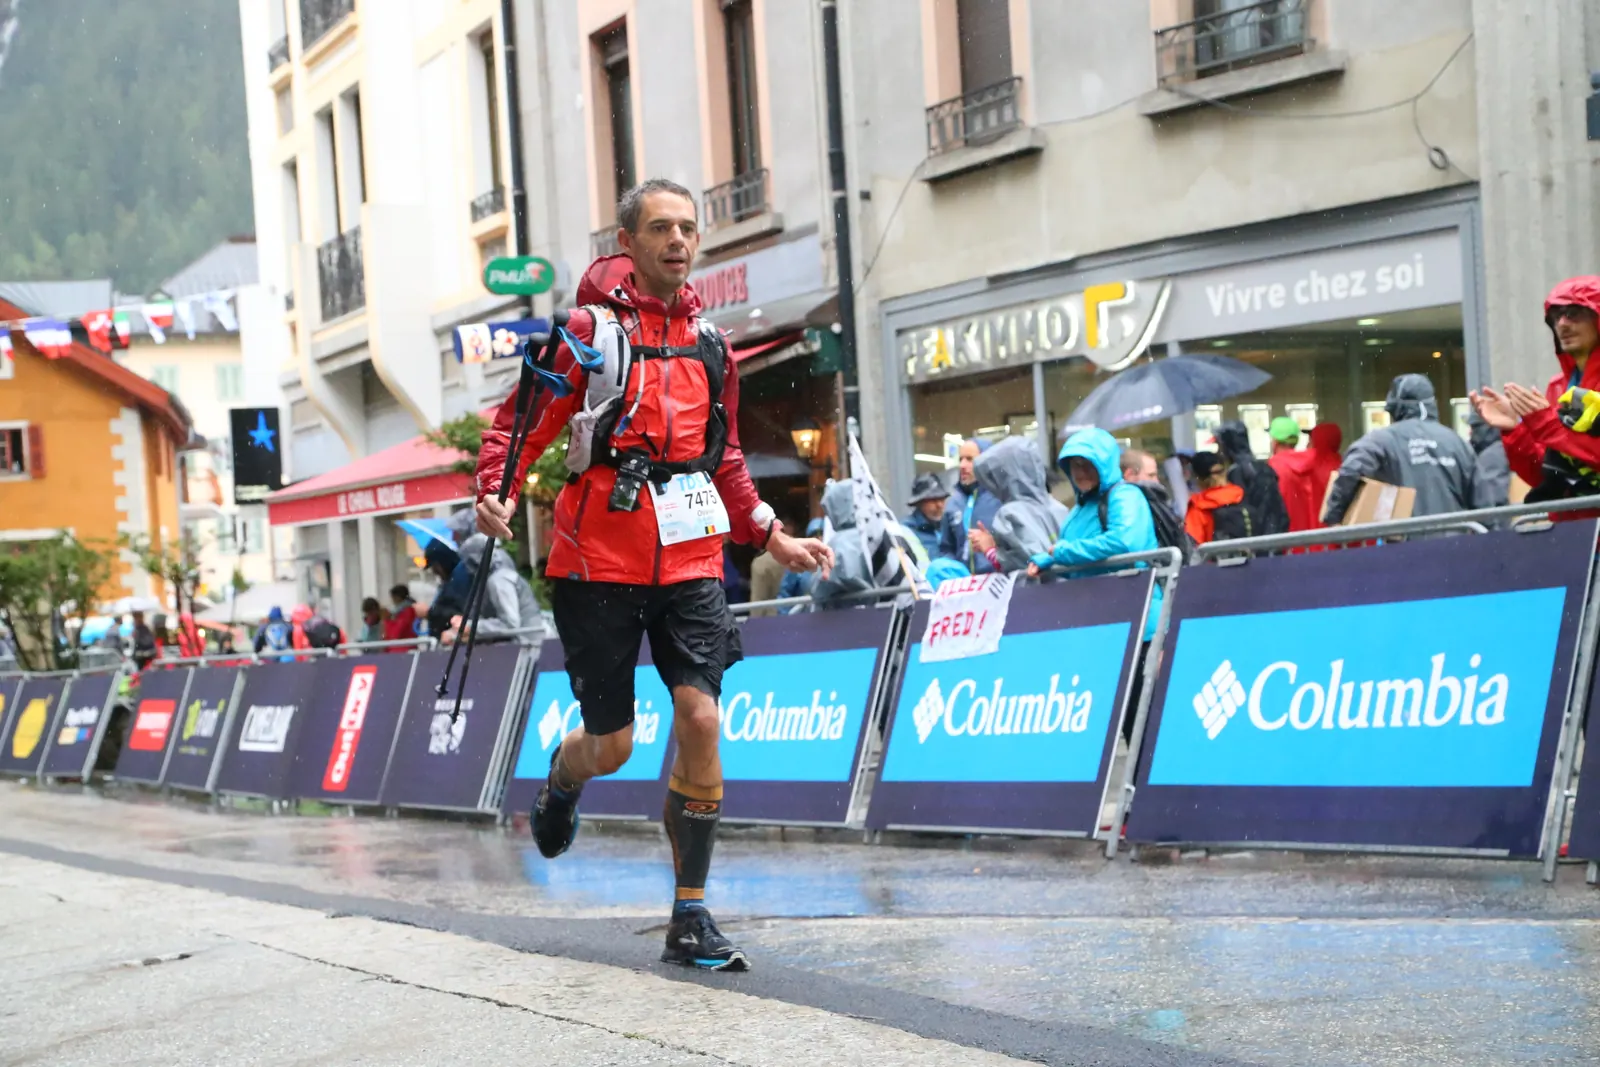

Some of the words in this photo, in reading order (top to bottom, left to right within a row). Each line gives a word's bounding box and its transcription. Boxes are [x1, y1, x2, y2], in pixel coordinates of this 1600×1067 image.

[1205, 282, 1286, 317] Vivre
[1293, 270, 1368, 305] chez
[1375, 253, 1425, 294] soi
[684, 490, 717, 509] 7475
[724, 690, 847, 741] Columbia
[943, 673, 1093, 736] Columbia
[1247, 653, 1509, 731] Columbia
